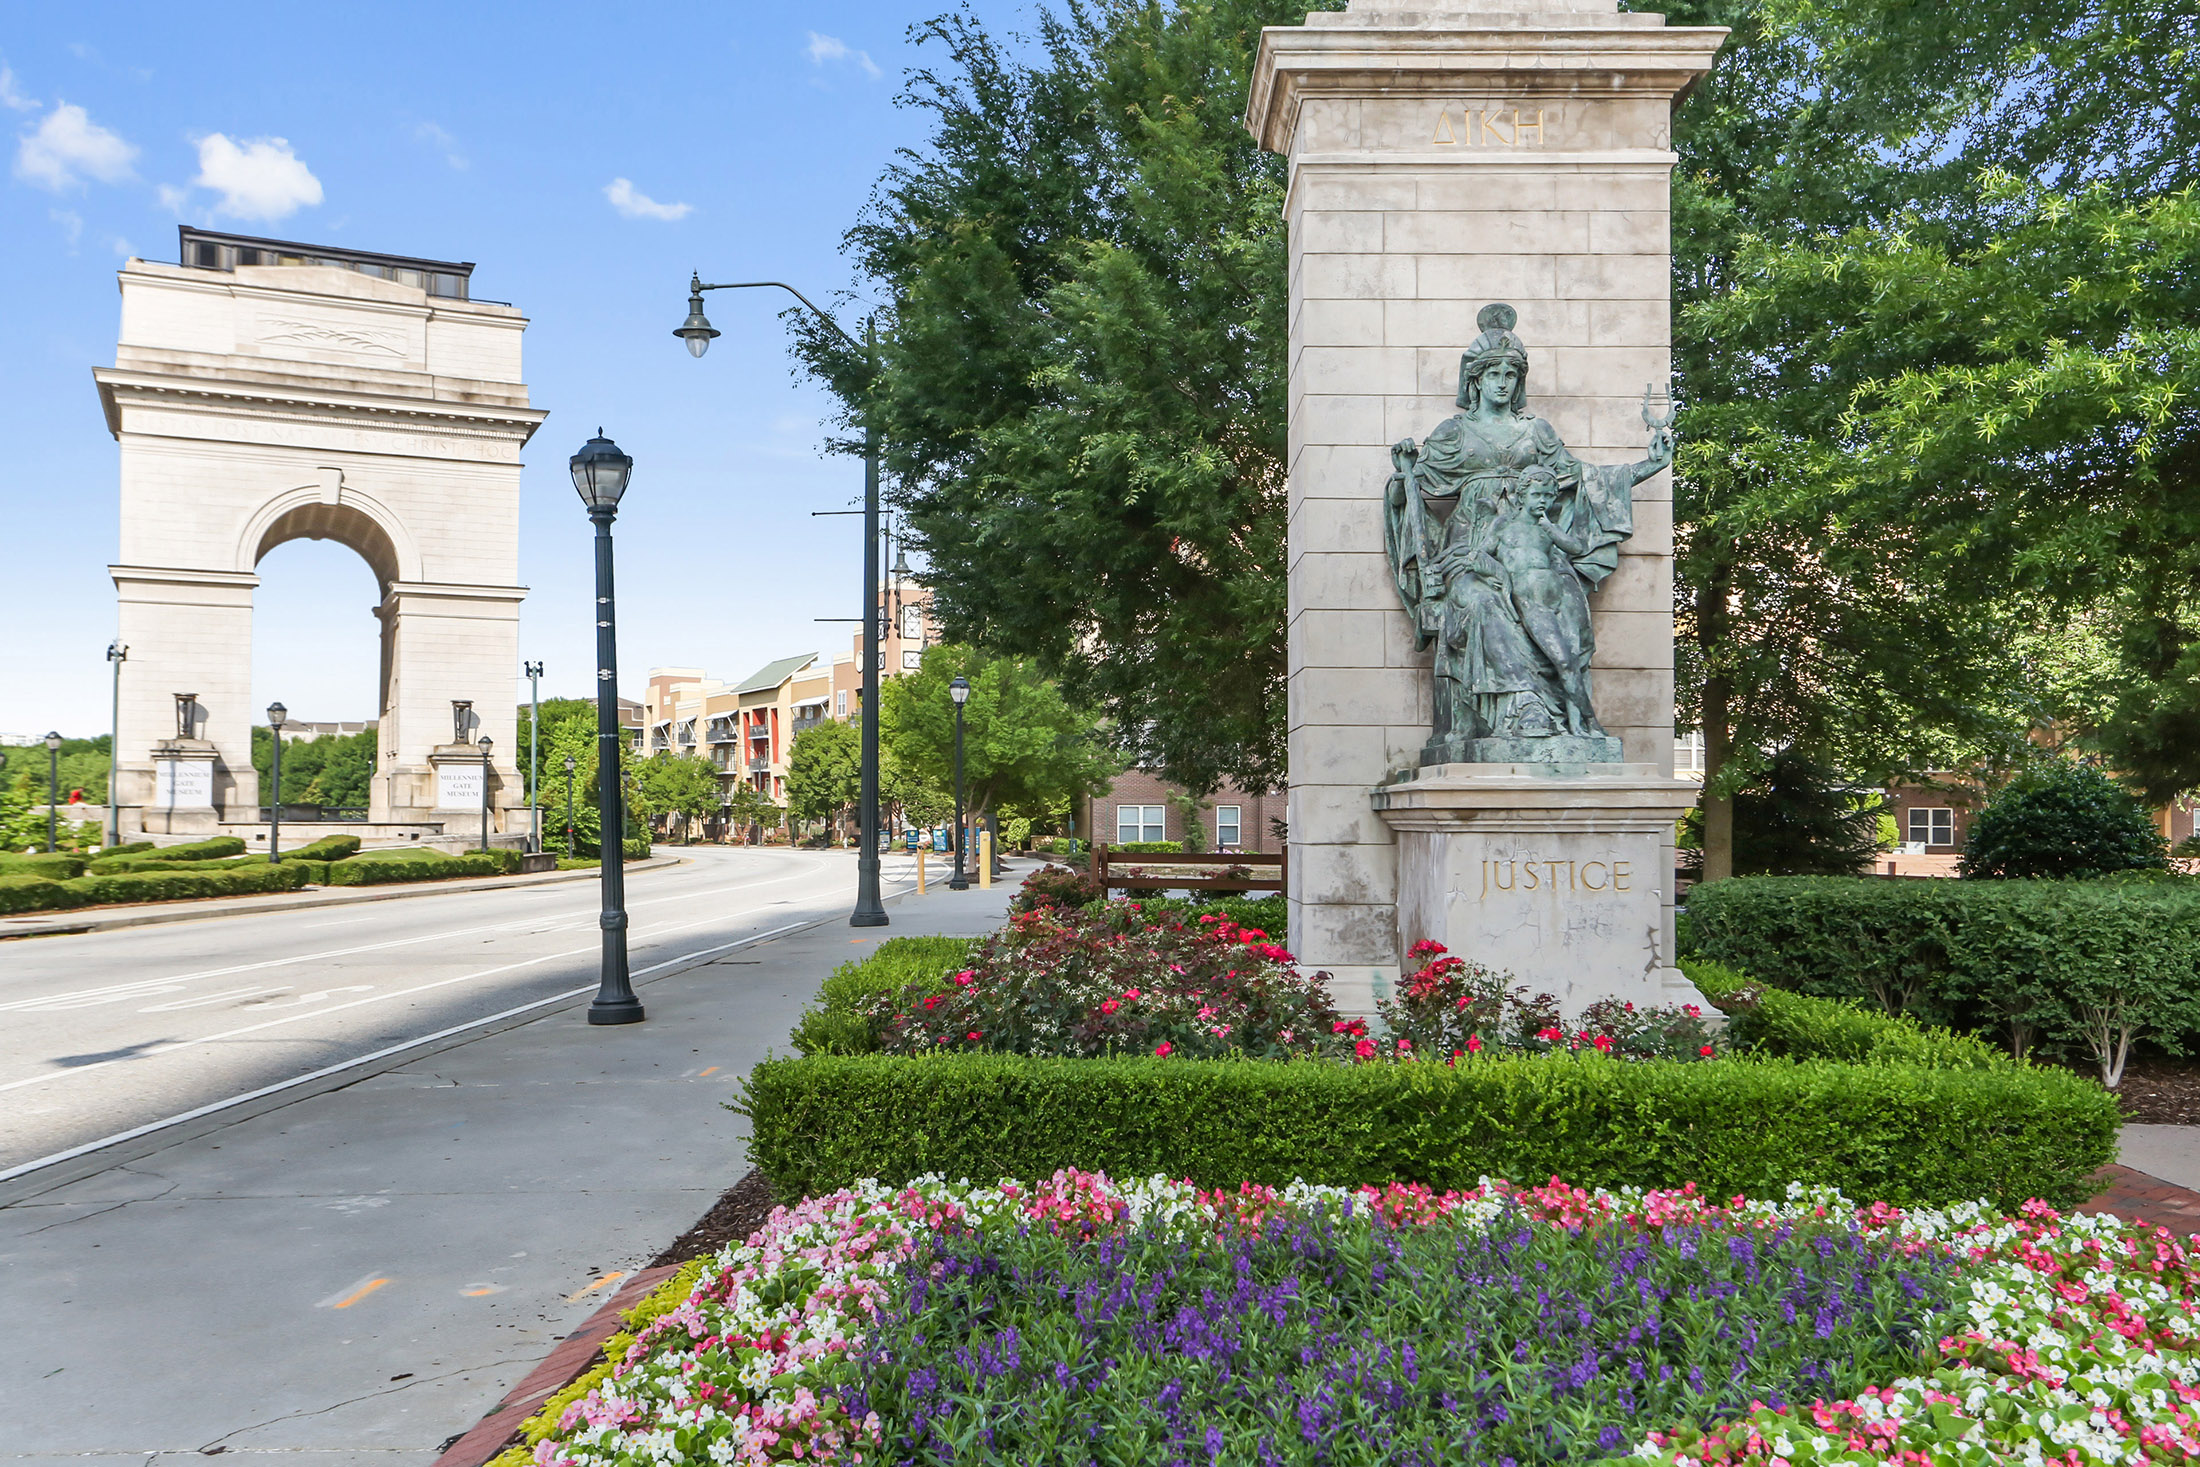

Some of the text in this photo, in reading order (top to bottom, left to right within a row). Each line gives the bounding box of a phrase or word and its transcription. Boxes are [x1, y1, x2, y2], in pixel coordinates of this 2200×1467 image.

[1431, 108, 1544, 145] ΔΙΚΗ
[475, 443, 514, 458] HOC
[1480, 860, 1632, 901] JUSTICE
[15, 985, 375, 1012] BUS
